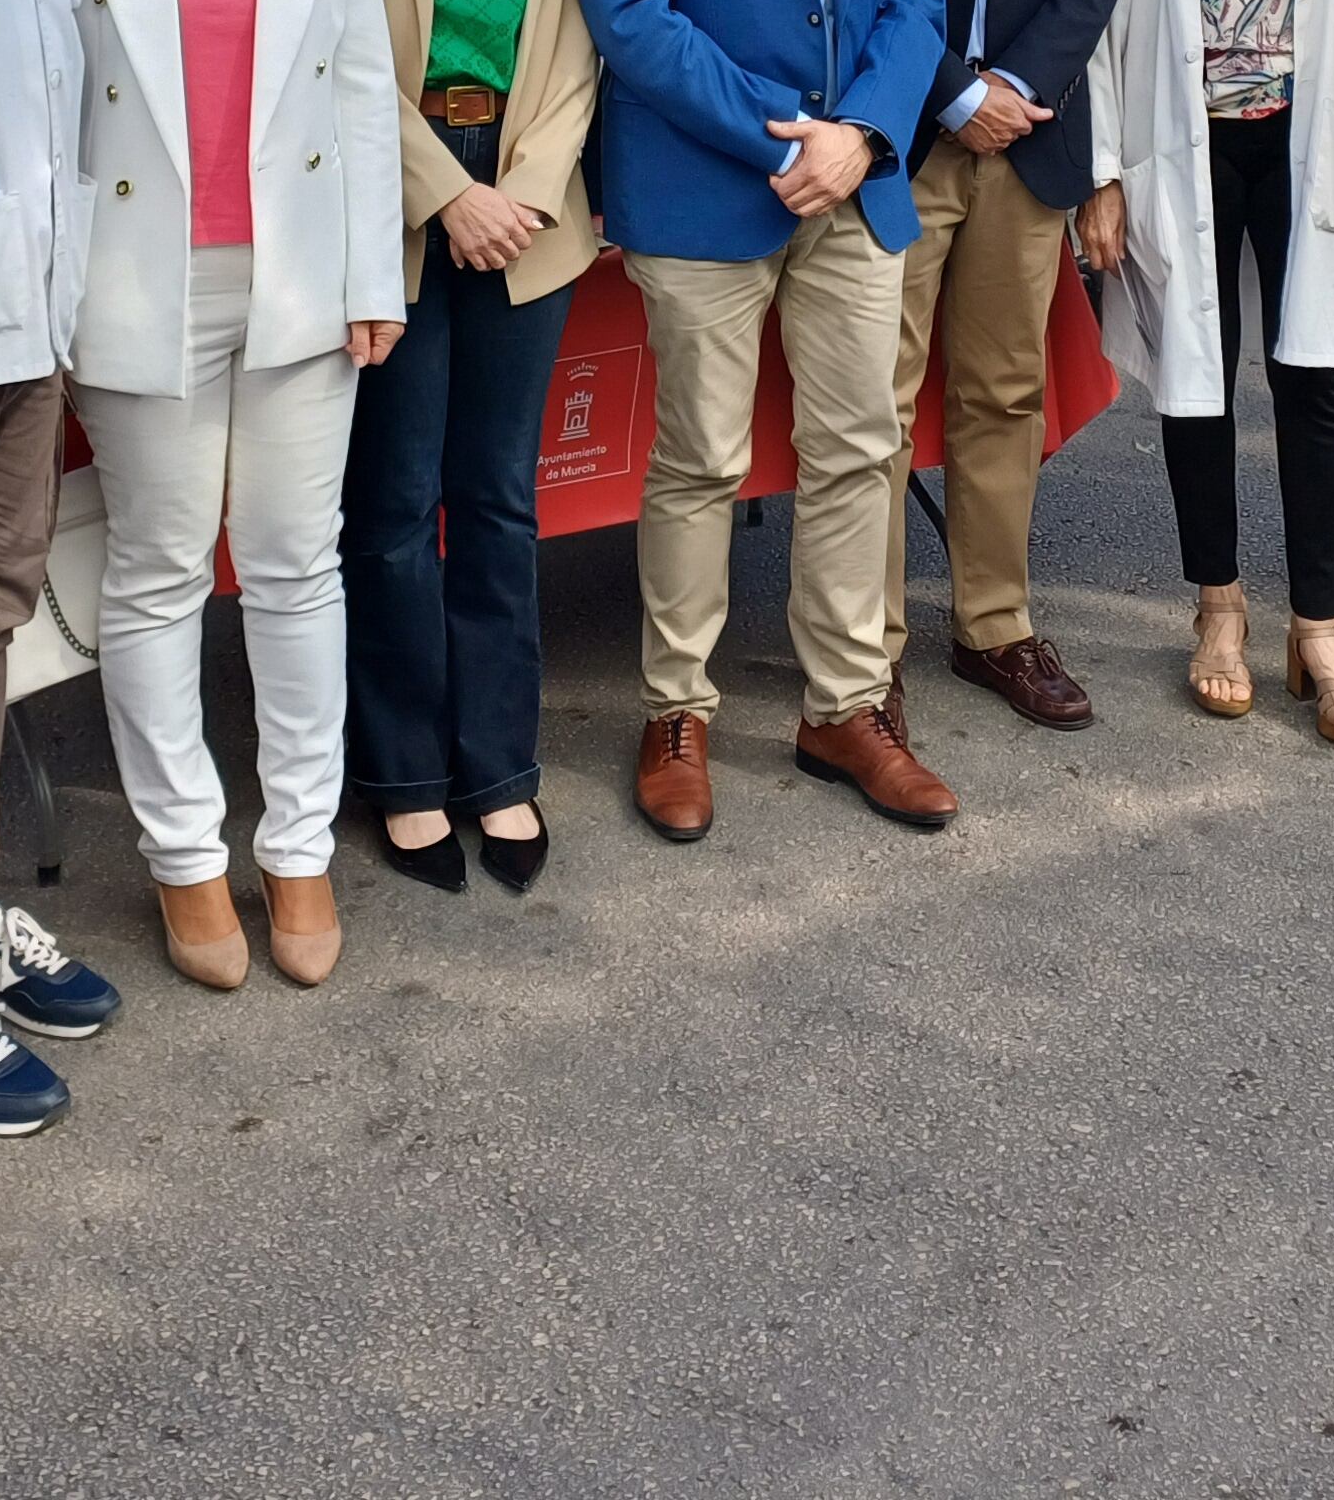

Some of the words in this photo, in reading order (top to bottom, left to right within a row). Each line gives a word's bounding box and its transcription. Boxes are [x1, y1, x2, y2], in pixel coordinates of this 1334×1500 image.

[537, 445, 607, 467] Ayuntamiento
[546, 469, 559, 481] de
[561, 462, 597, 478] Murcia
